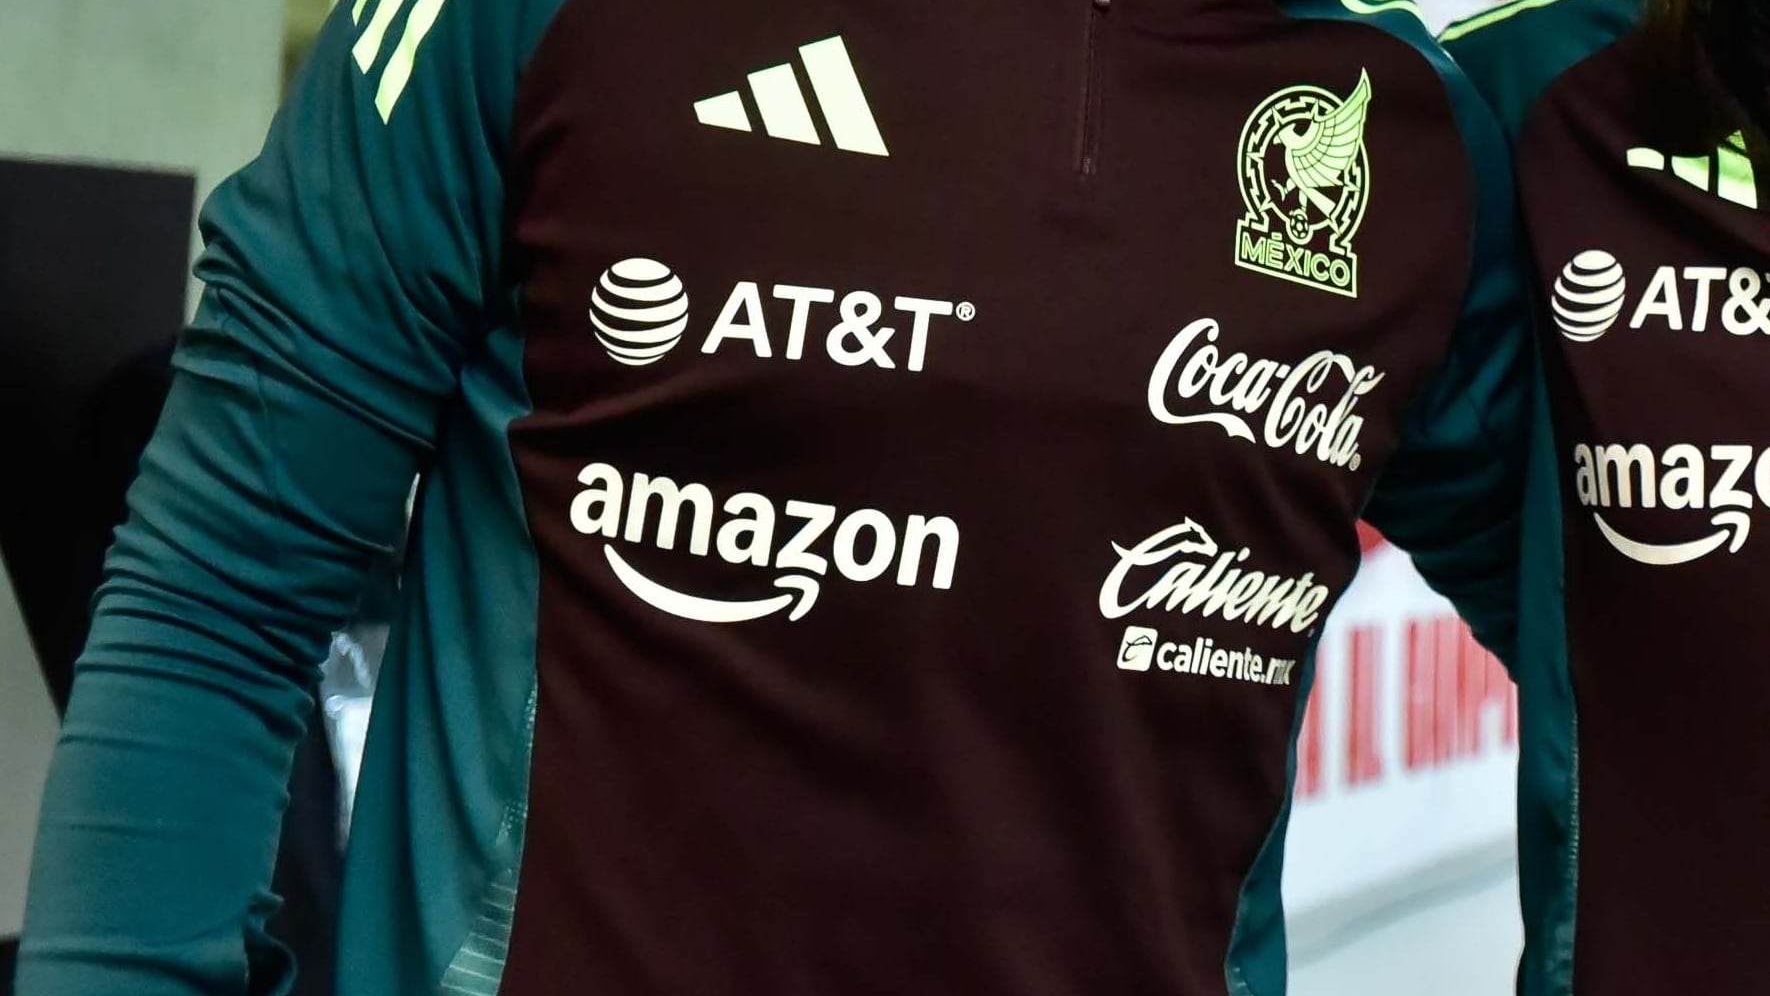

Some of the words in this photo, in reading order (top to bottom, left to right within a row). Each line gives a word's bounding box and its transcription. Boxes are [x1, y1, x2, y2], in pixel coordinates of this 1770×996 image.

[1241, 232, 1351, 287] MÉXICO
[1148, 318, 1385, 469] Coca-Cola
[570, 462, 960, 590] amazon
[1157, 637, 1297, 685] caliente.mx
